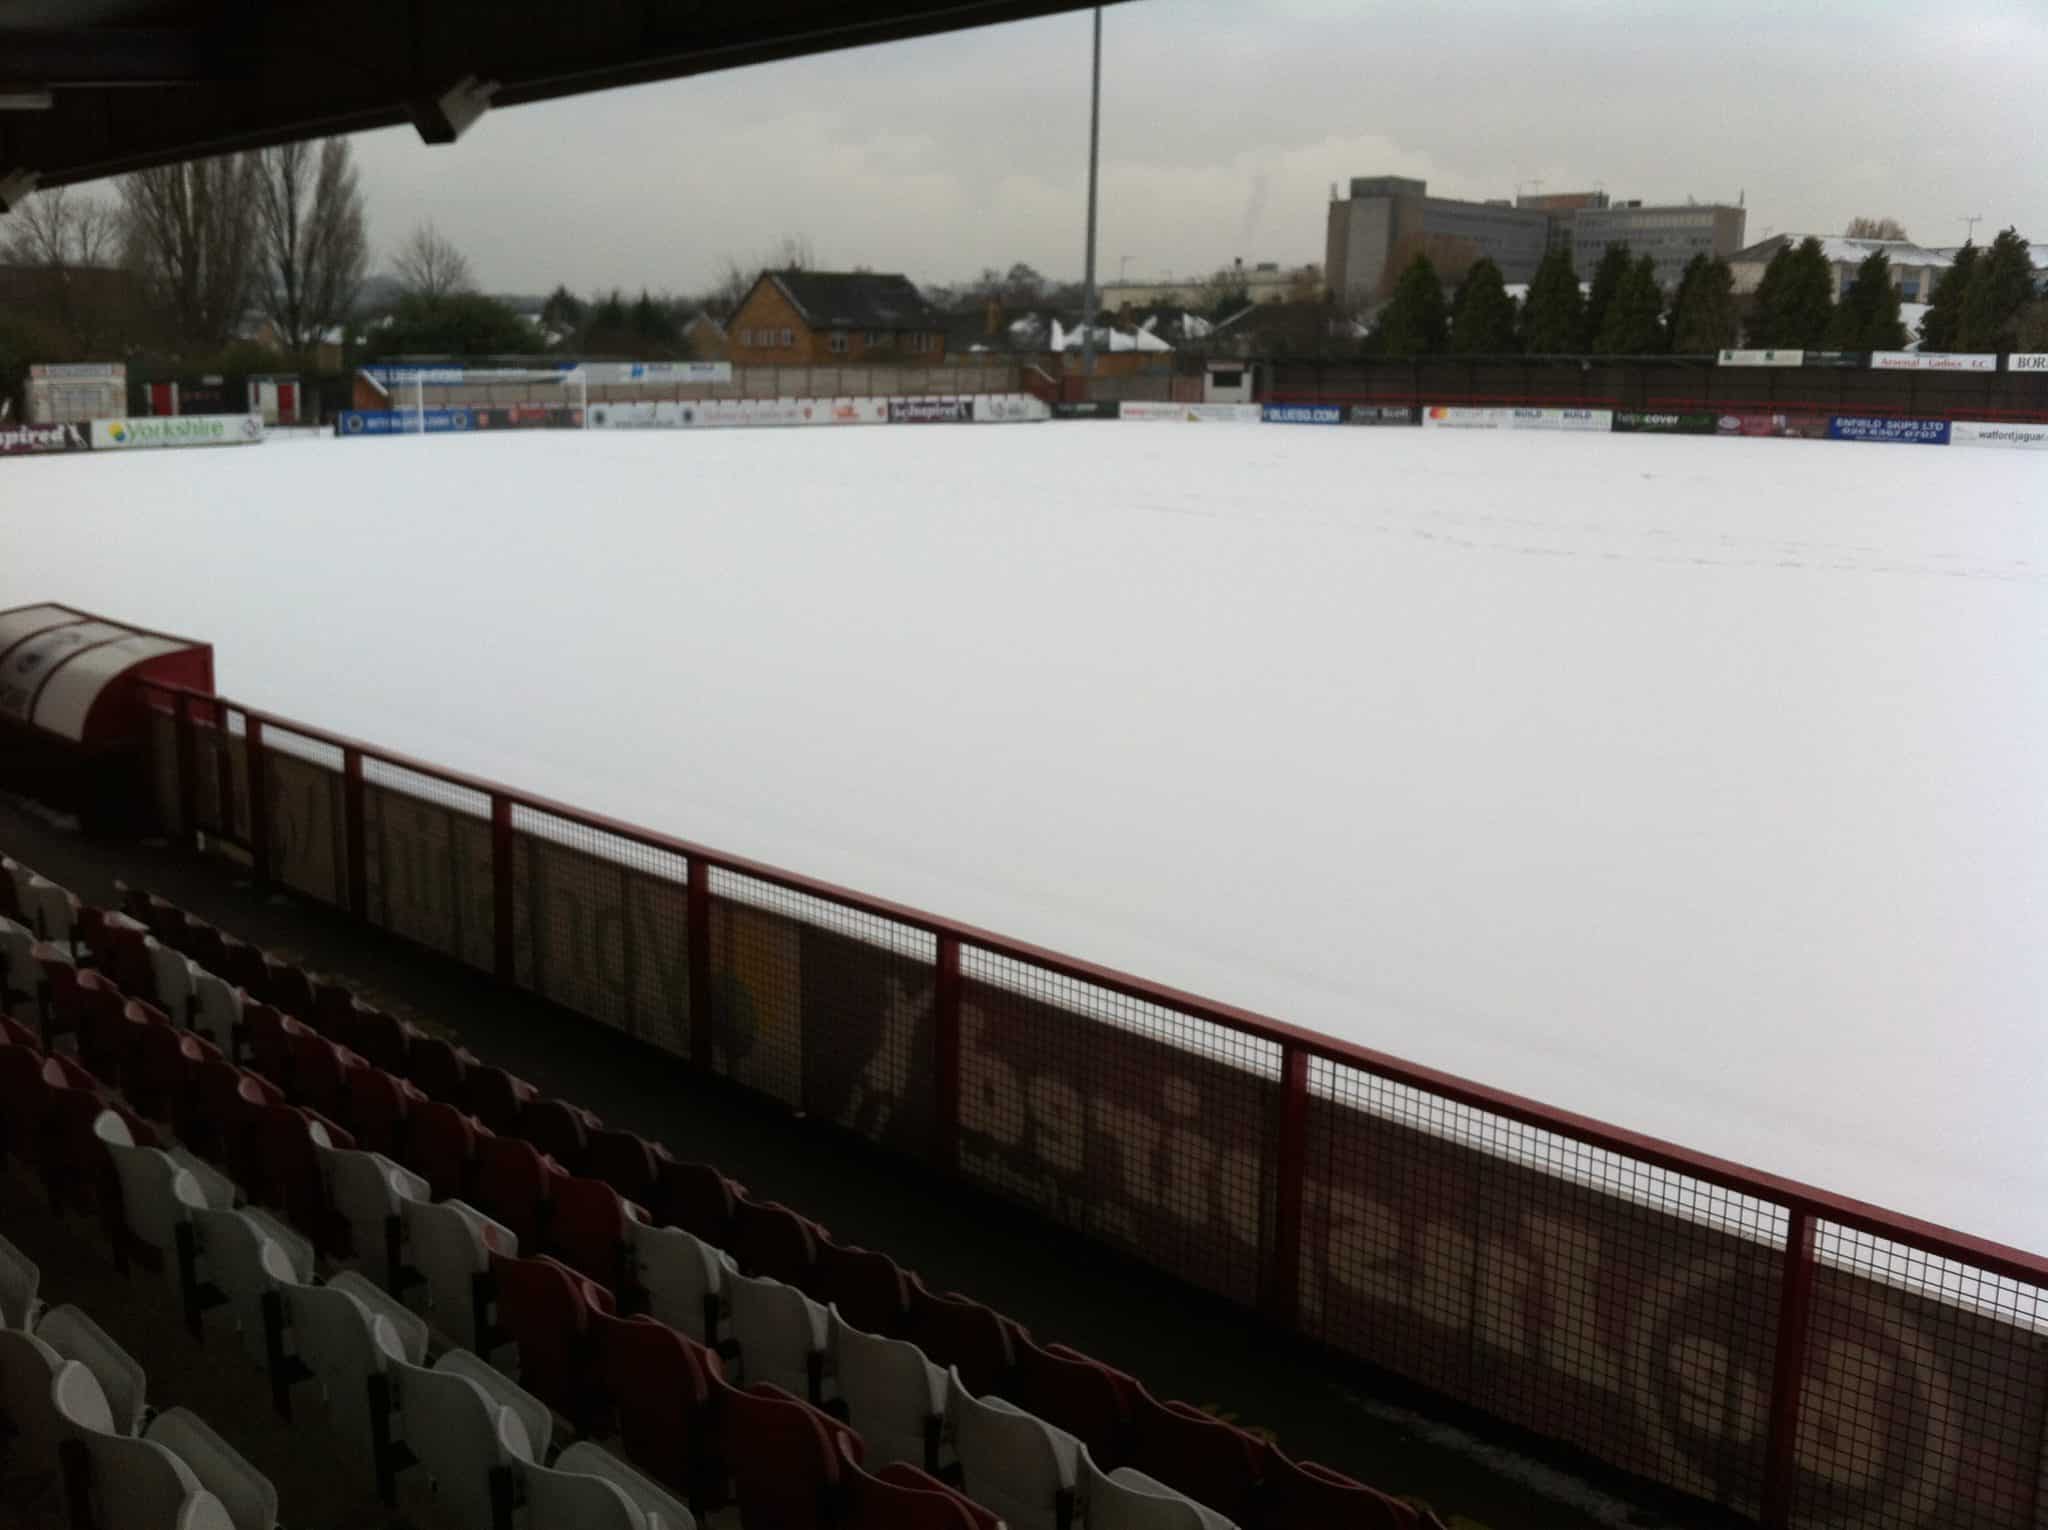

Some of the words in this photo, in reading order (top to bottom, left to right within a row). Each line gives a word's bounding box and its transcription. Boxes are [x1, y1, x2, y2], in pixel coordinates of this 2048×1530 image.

[1836, 418, 1881, 428] ENFIELD
[1886, 421, 1917, 430] SKIPS
[1921, 422, 1944, 431] LTD
